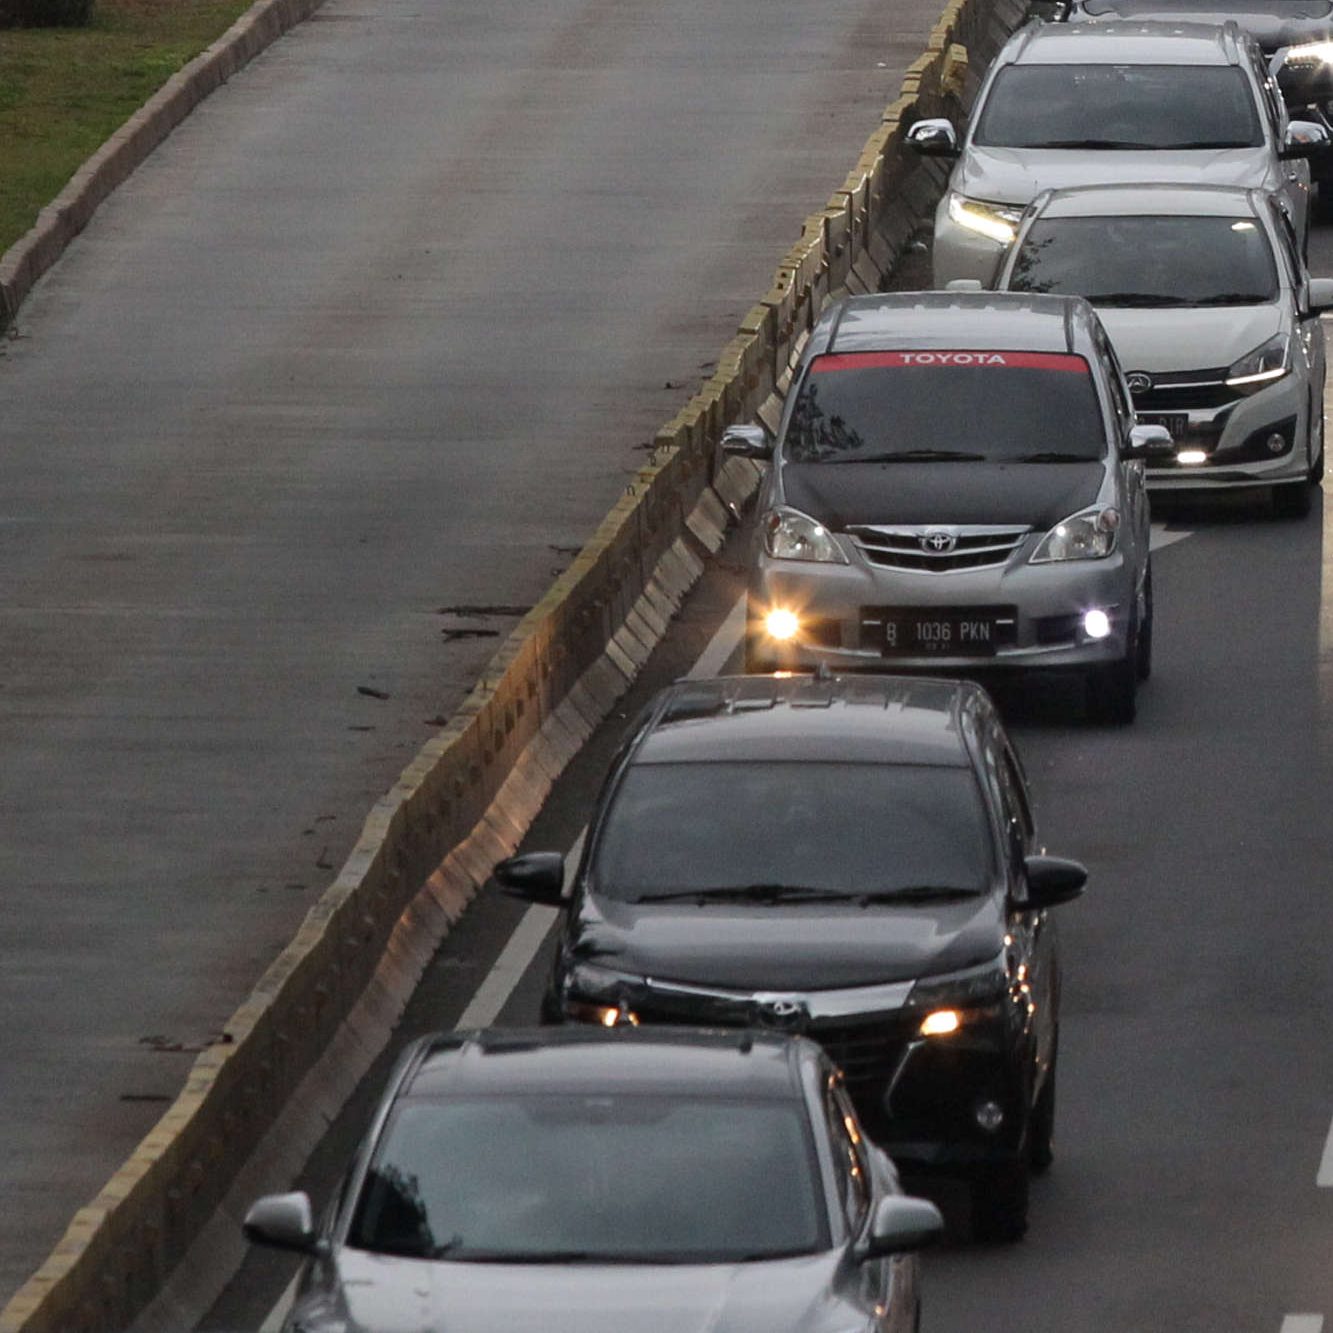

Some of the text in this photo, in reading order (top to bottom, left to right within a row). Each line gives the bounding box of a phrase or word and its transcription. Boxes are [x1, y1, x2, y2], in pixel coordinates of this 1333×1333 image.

[900, 352, 1007, 365] TOYOTA
[886, 622, 991, 643] B 1036 PKN
